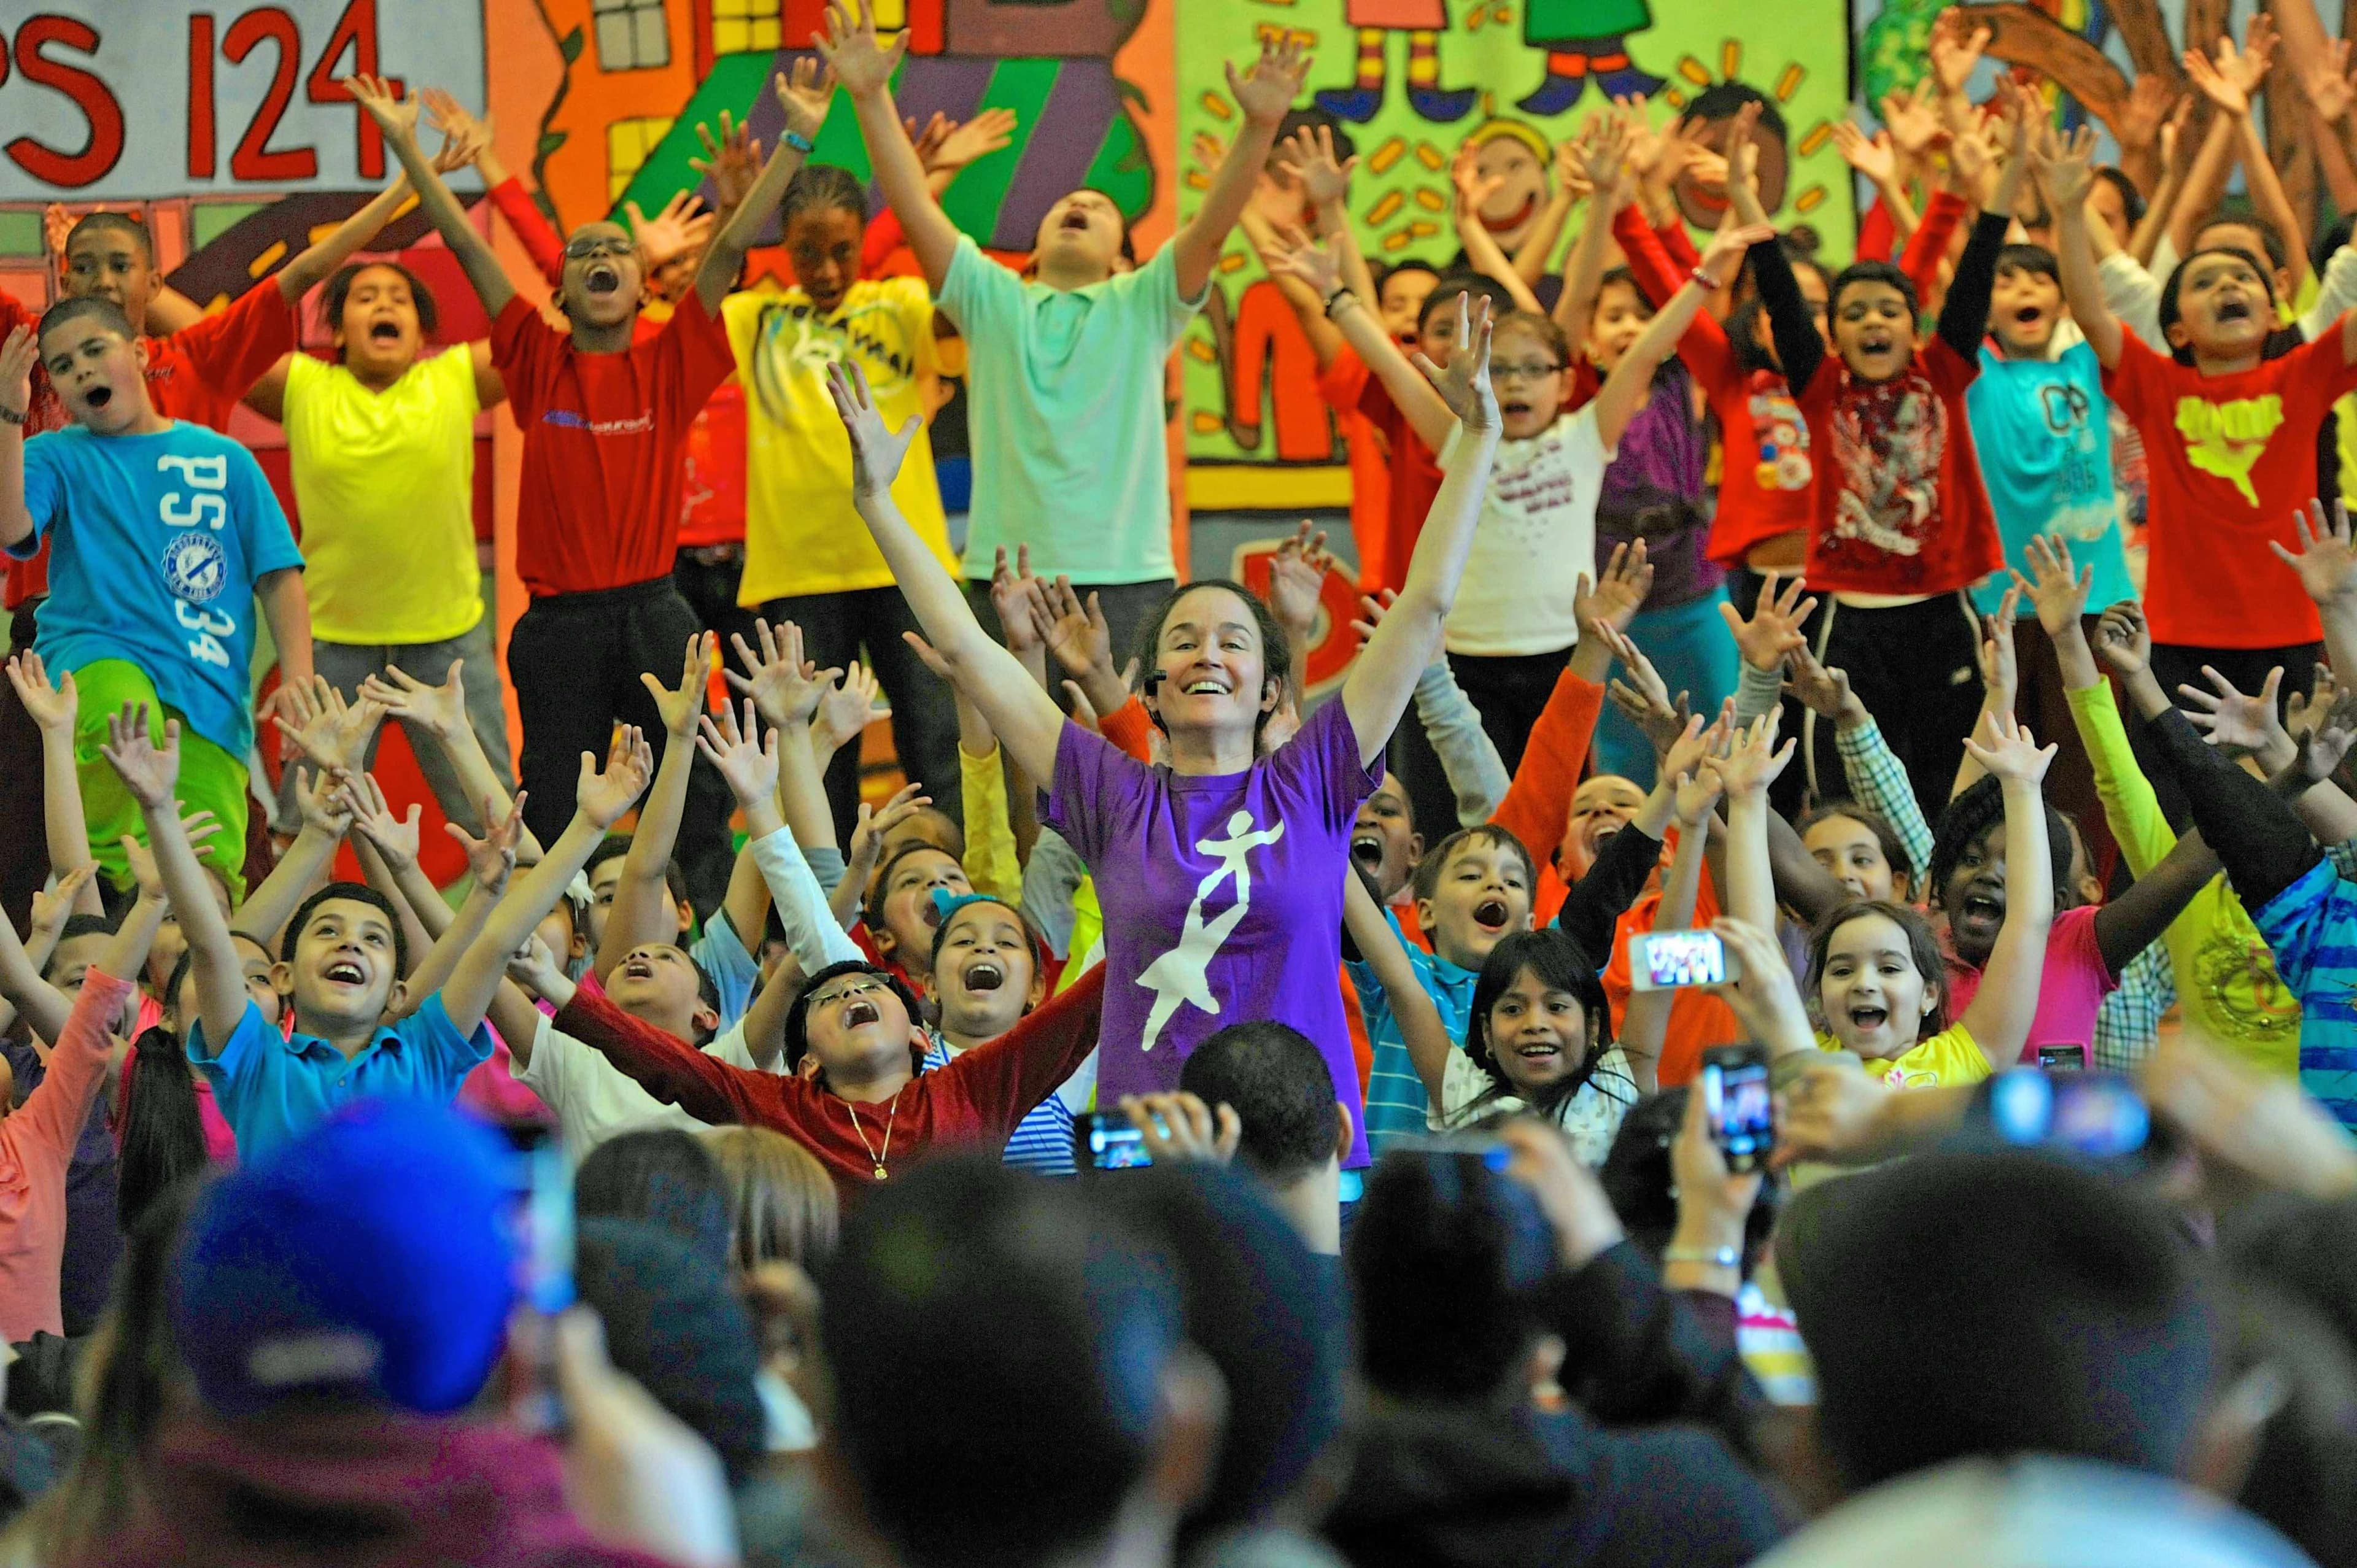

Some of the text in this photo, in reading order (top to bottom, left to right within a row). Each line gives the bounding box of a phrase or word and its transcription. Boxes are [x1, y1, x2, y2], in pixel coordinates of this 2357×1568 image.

[0, 0, 405, 189] S 124
[157, 455, 226, 530] PS
[176, 599, 234, 668] 34
